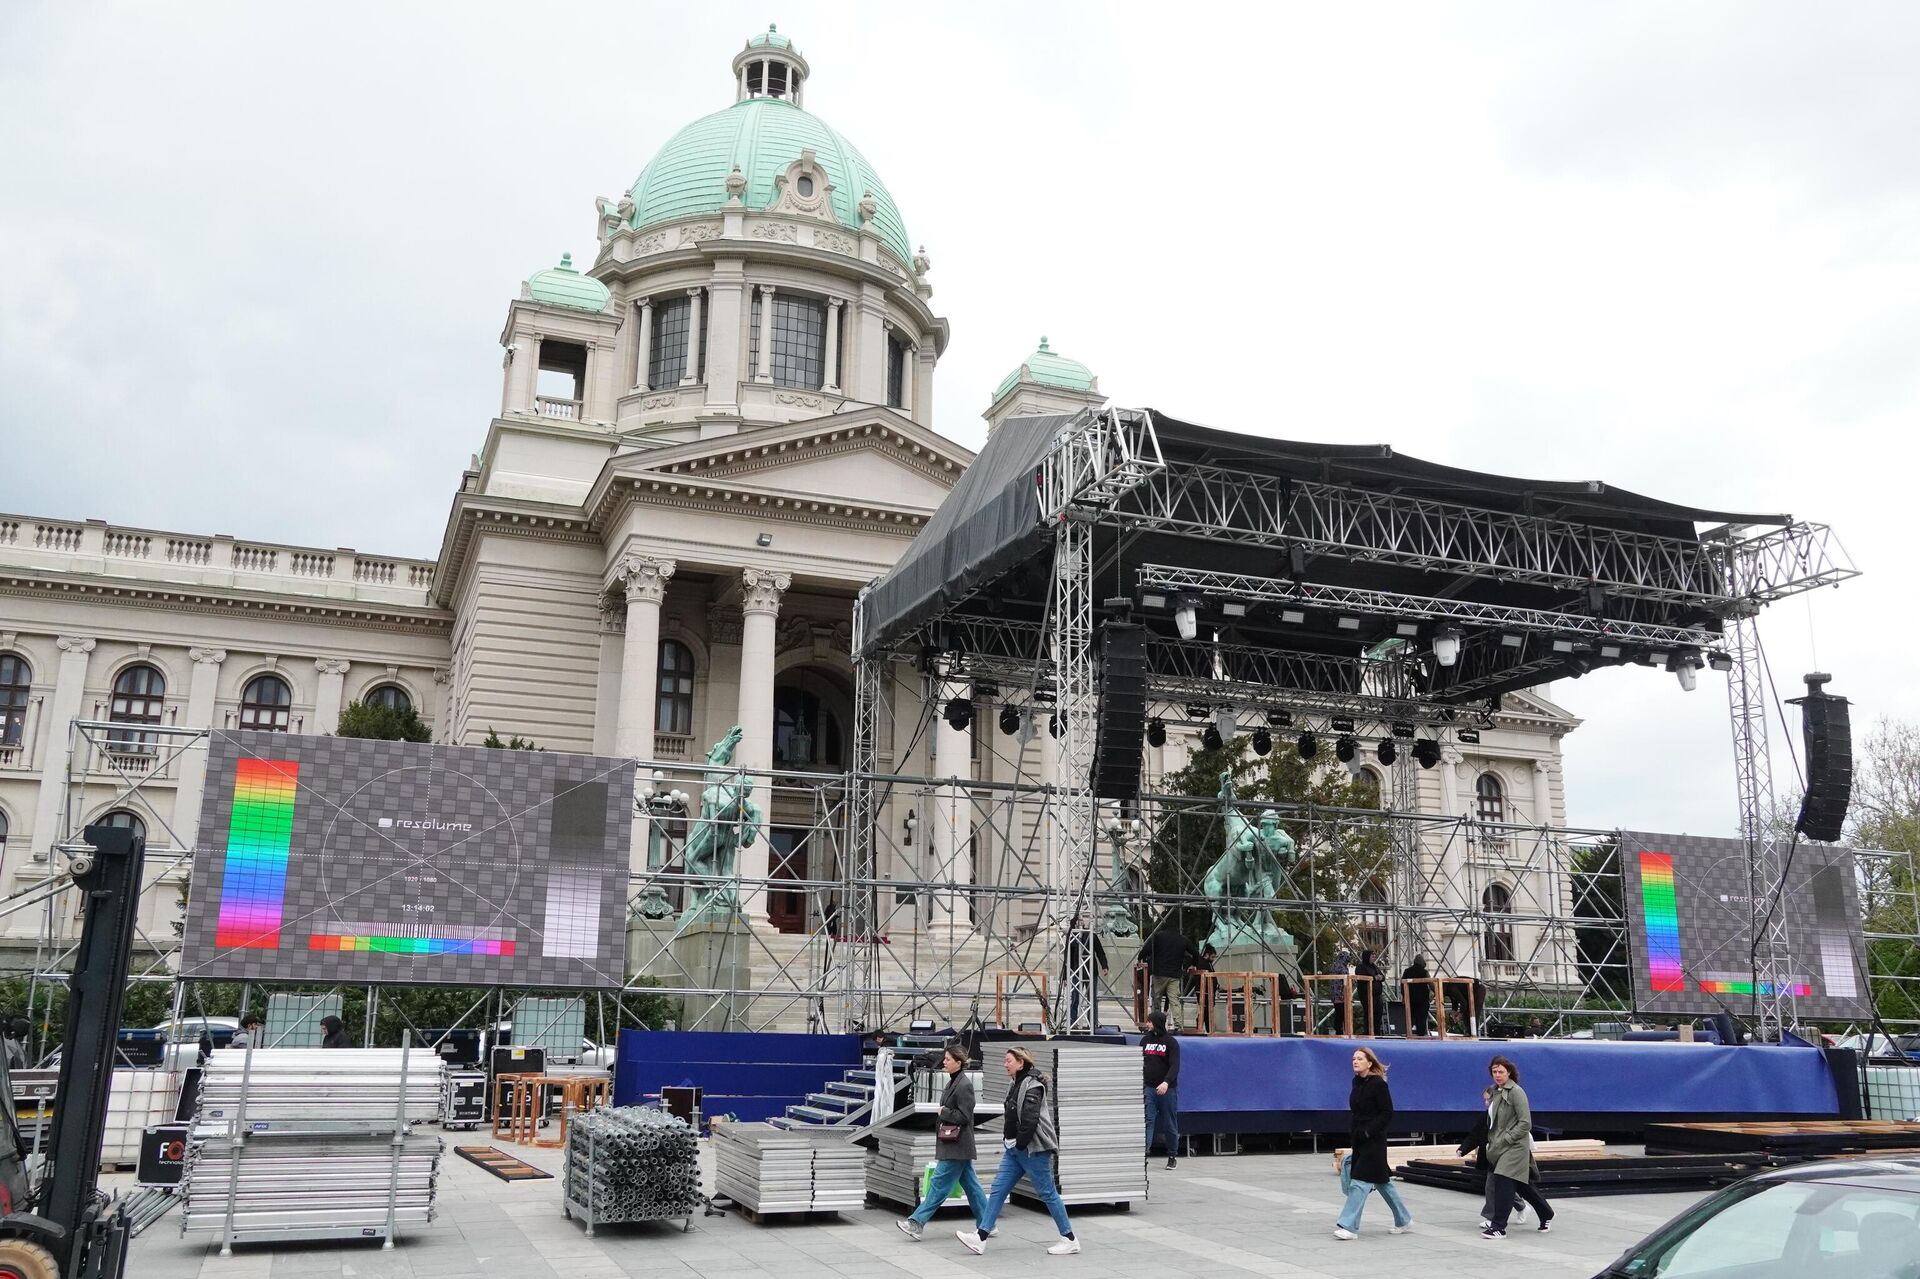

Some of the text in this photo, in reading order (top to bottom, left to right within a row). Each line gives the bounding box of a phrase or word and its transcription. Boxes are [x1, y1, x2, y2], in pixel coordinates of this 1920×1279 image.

[396, 818, 472, 832] resolume
[401, 904, 435, 912] 13:14:02
[1157, 1044, 1167, 1052] DO
